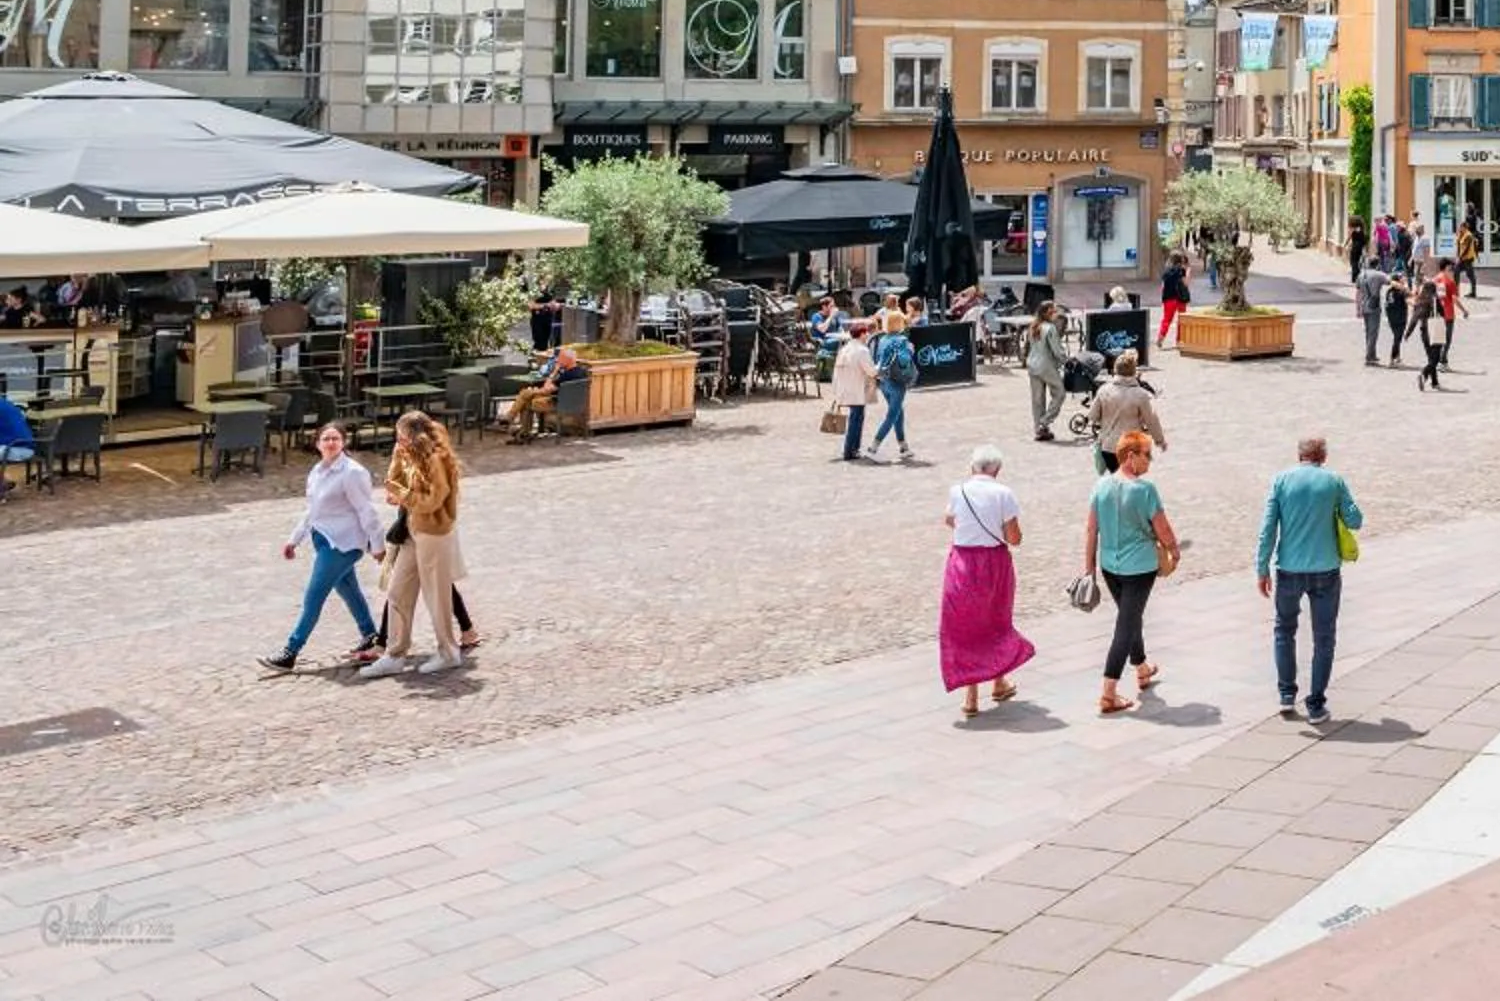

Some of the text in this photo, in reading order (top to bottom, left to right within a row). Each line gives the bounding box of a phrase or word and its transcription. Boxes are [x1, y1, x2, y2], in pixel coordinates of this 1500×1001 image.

[407, 141, 427, 152] LA
[436, 138, 501, 152] RÉUNION
[573, 134, 641, 146] BOUTIQUES
[723, 133, 773, 145] PARKING
[914, 149, 1111, 164] BQUE POPULAIRE
